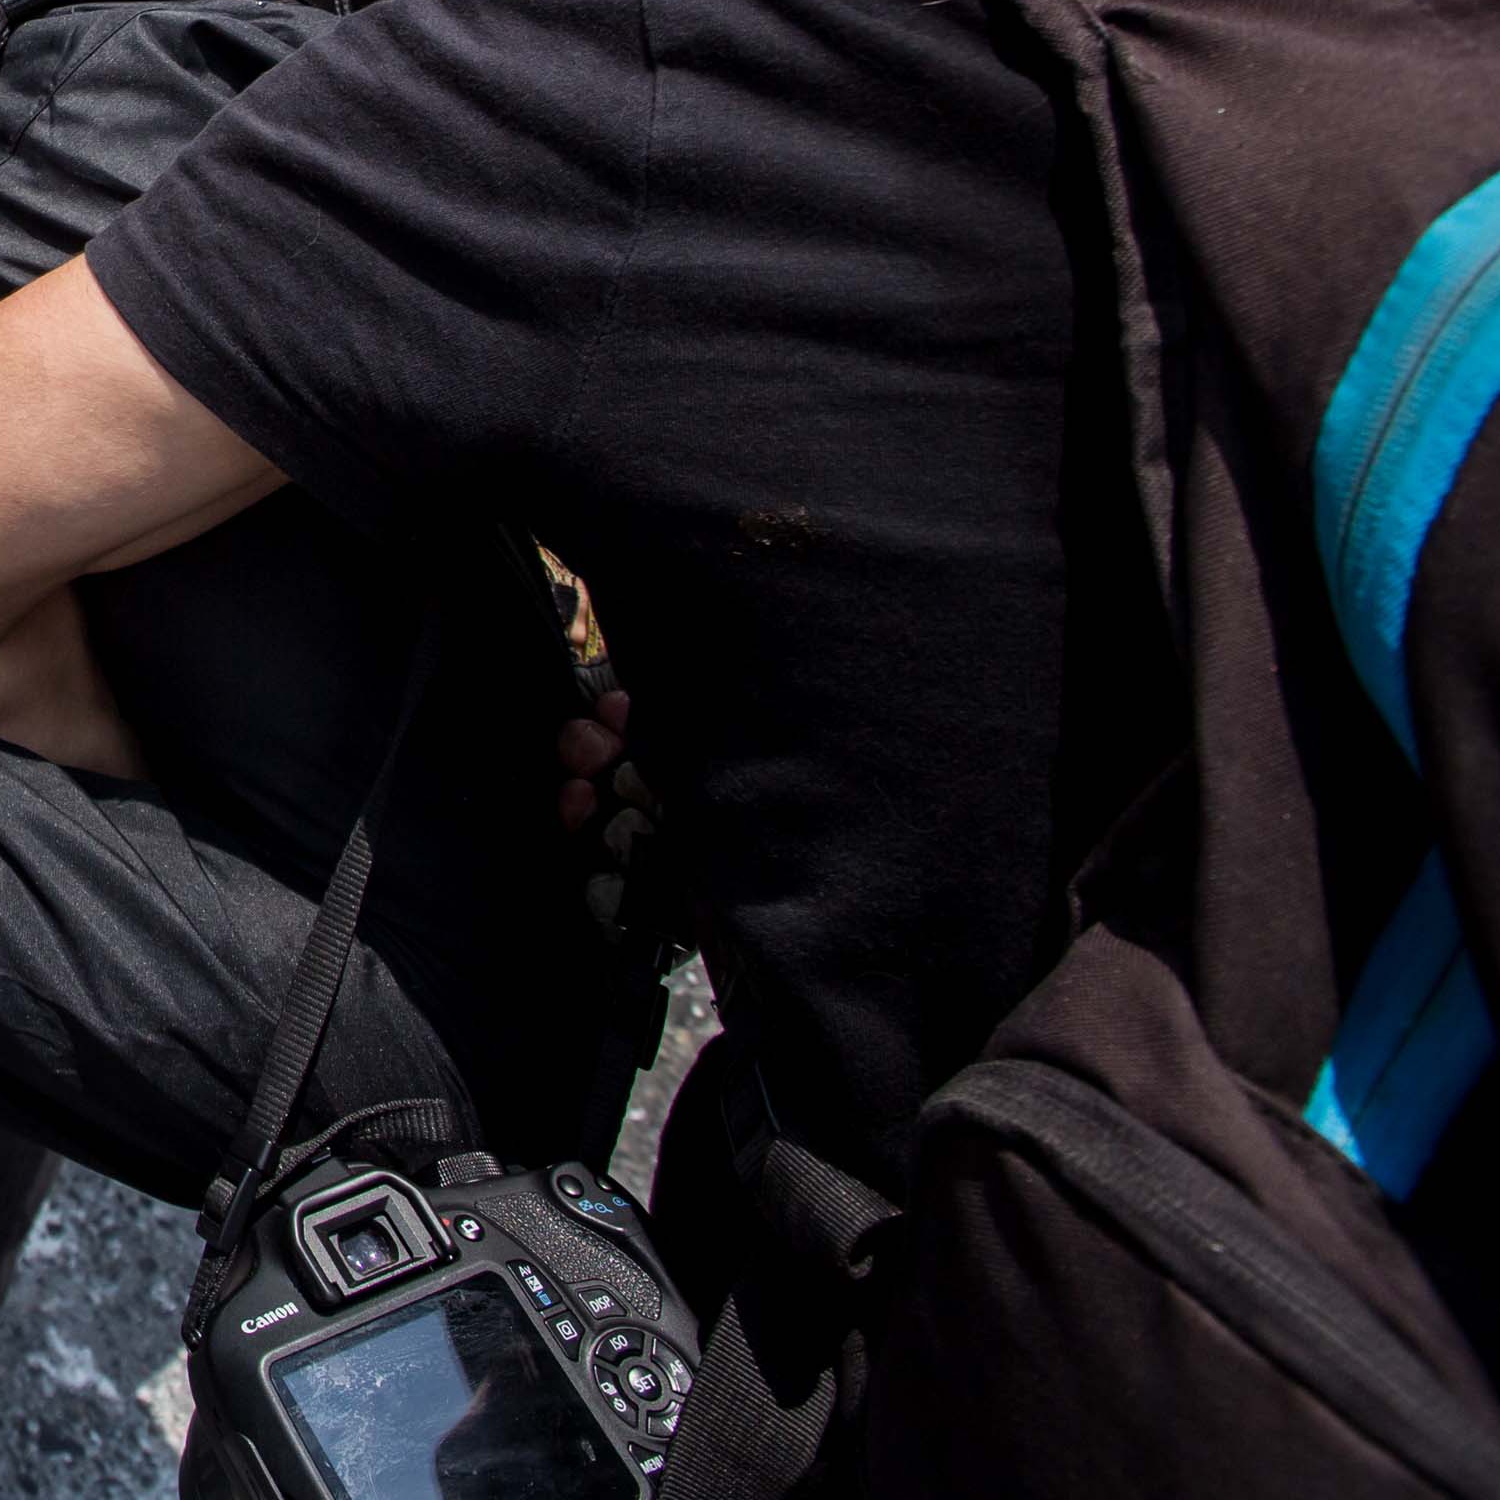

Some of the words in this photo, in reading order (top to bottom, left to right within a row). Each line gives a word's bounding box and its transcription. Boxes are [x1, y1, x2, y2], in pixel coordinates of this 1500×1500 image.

[588, 1295, 615, 1313] DISP.
[240, 1300, 299, 1335] Canon
[609, 1334, 628, 1350] ISO
[669, 1359, 684, 1376] AF
[633, 1374, 656, 1393] SET
